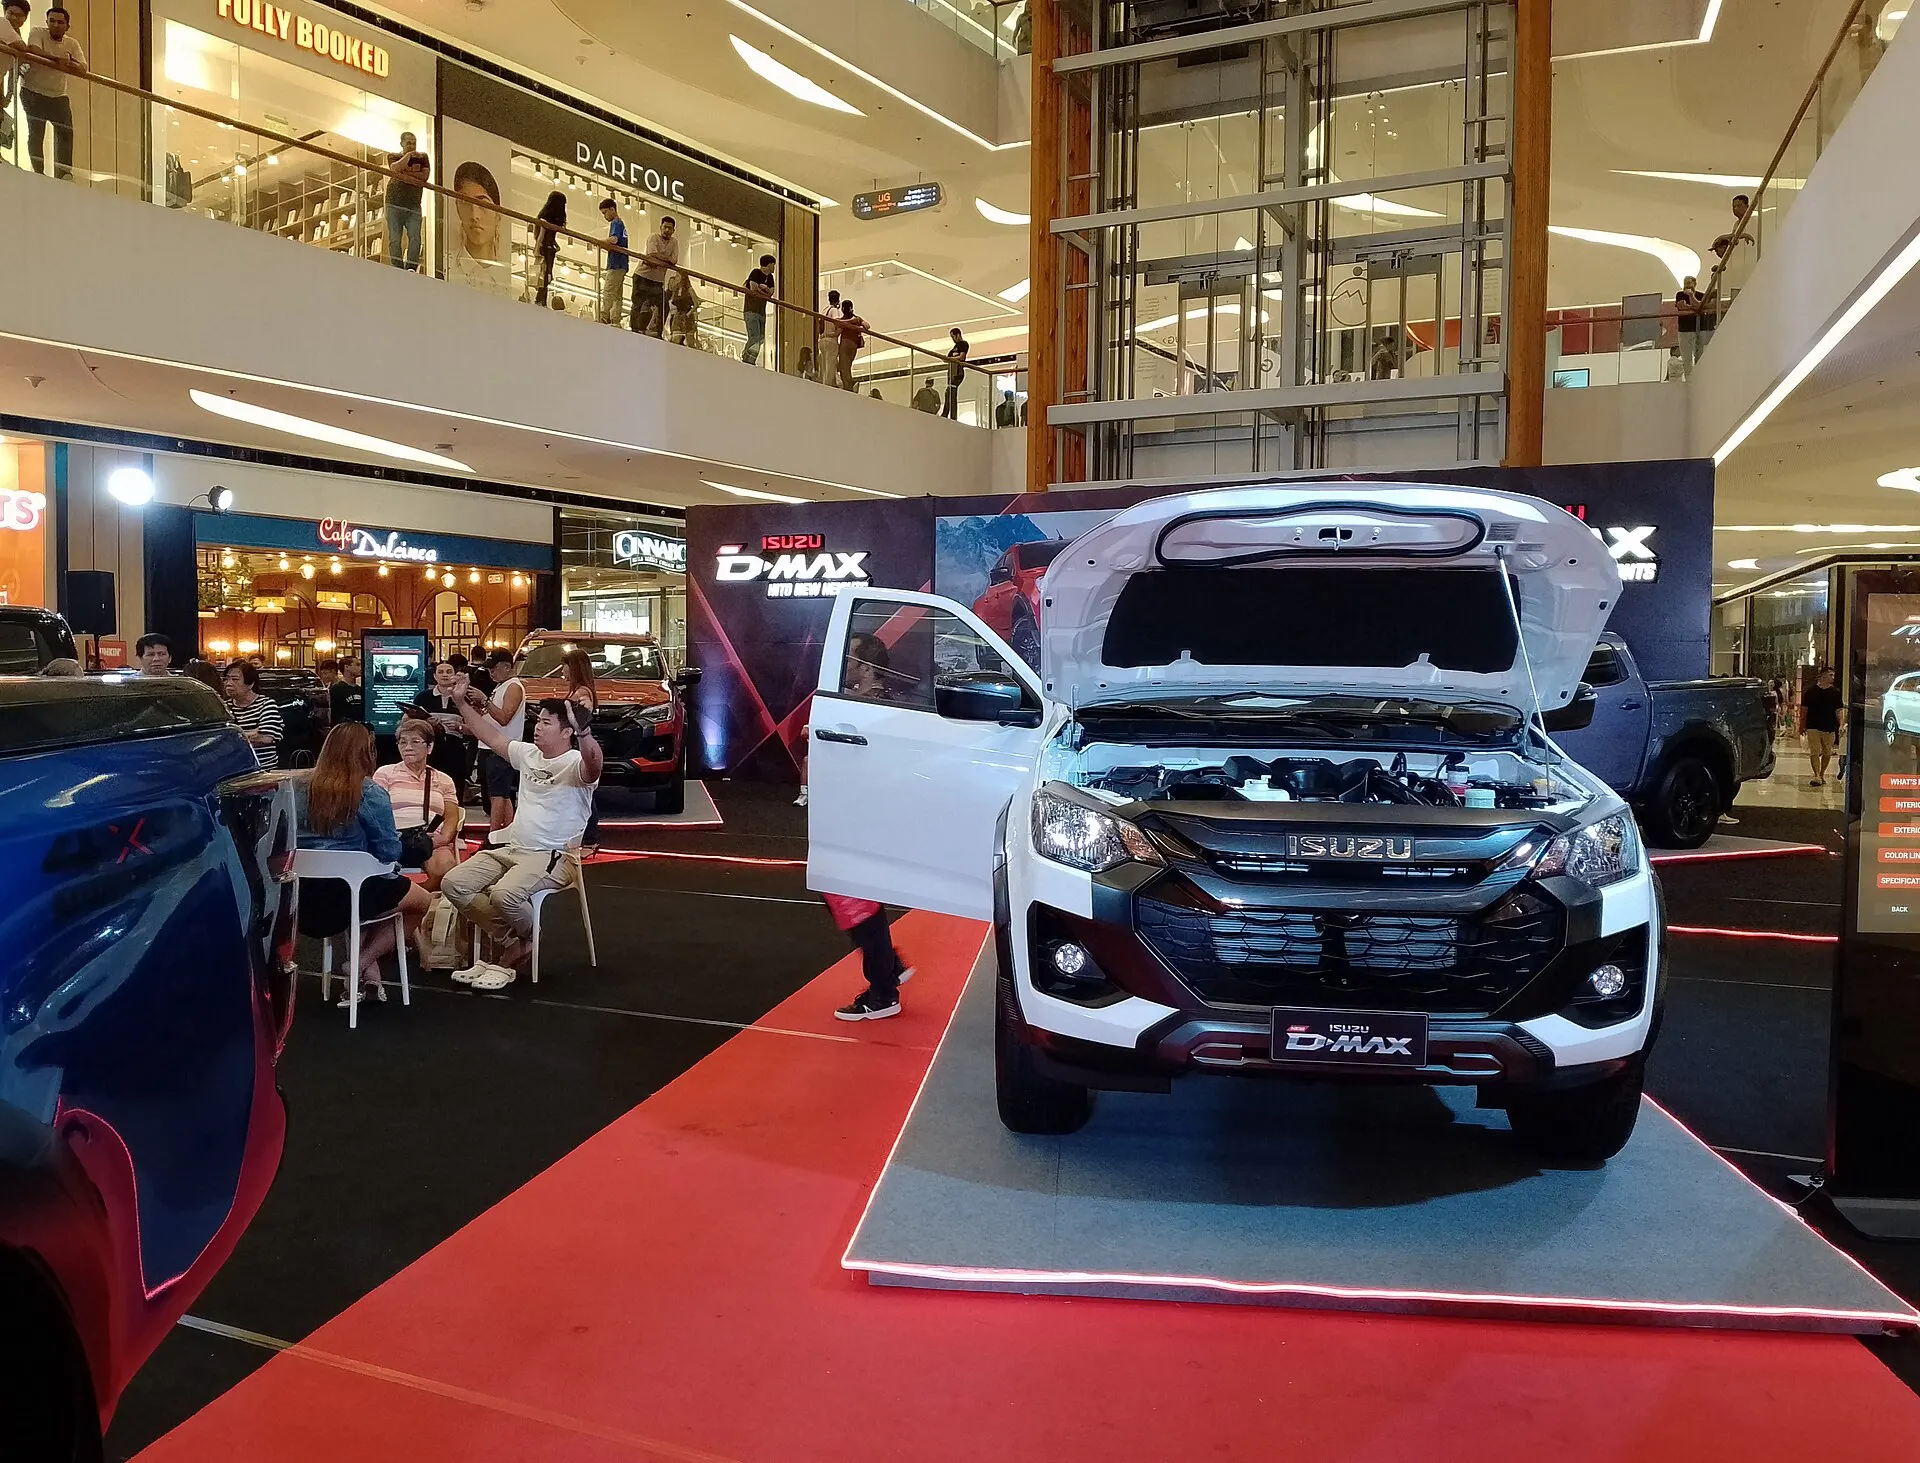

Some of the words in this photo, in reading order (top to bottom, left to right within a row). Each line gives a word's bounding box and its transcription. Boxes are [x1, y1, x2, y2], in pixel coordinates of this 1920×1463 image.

[296, 16, 390, 78] BOOKED
[576, 141, 685, 203] PARFOIS
[878, 192, 891, 202] UG
[319, 516, 353, 551] Cafe
[351, 528, 438, 562] Dulcinea
[762, 534, 822, 550] ISUZU
[794, 582, 821, 597] NEW
[97, 647, 121, 657] UNKIN'
[1890, 778, 1917, 786] WHAT'S
[1288, 835, 1411, 859] ISUZU
[1884, 851, 1908, 859] COLOR
[1891, 905, 1909, 913] BACK
[1329, 1023, 1370, 1034] ISUZU
